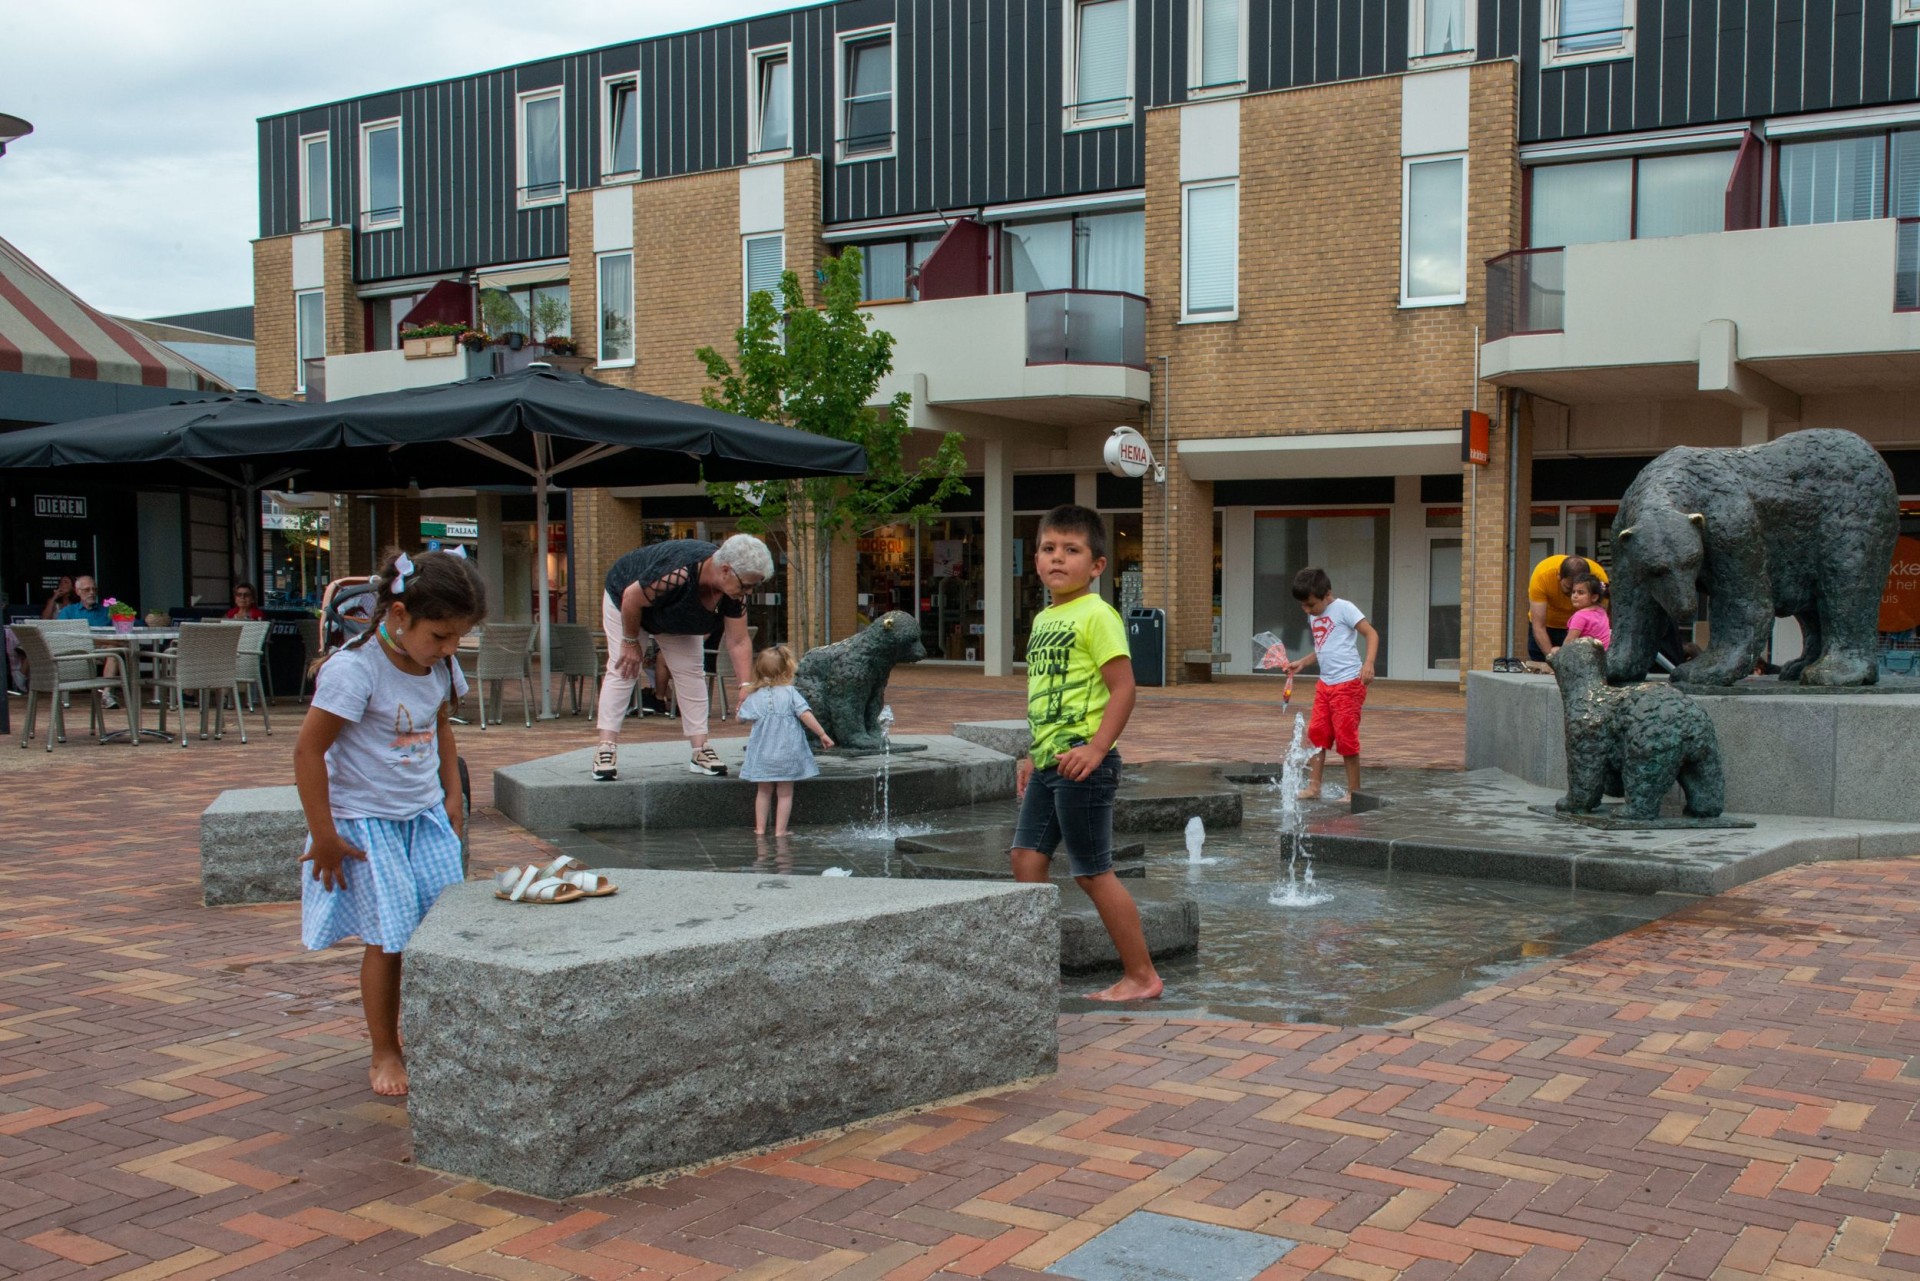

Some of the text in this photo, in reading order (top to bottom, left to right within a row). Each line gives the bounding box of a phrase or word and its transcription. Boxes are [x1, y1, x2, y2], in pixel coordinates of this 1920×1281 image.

[1120, 443, 1147, 463] HEMA
[38, 498, 84, 515] DIEREN
[44, 539, 60, 548] HIGH
[60, 540, 71, 548] TEA
[45, 552, 77, 561] HIGH WINE
[1889, 560, 1920, 576] kke
[1881, 593, 1899, 604] uis
[1039, 620, 1075, 632] SIXTY-2
